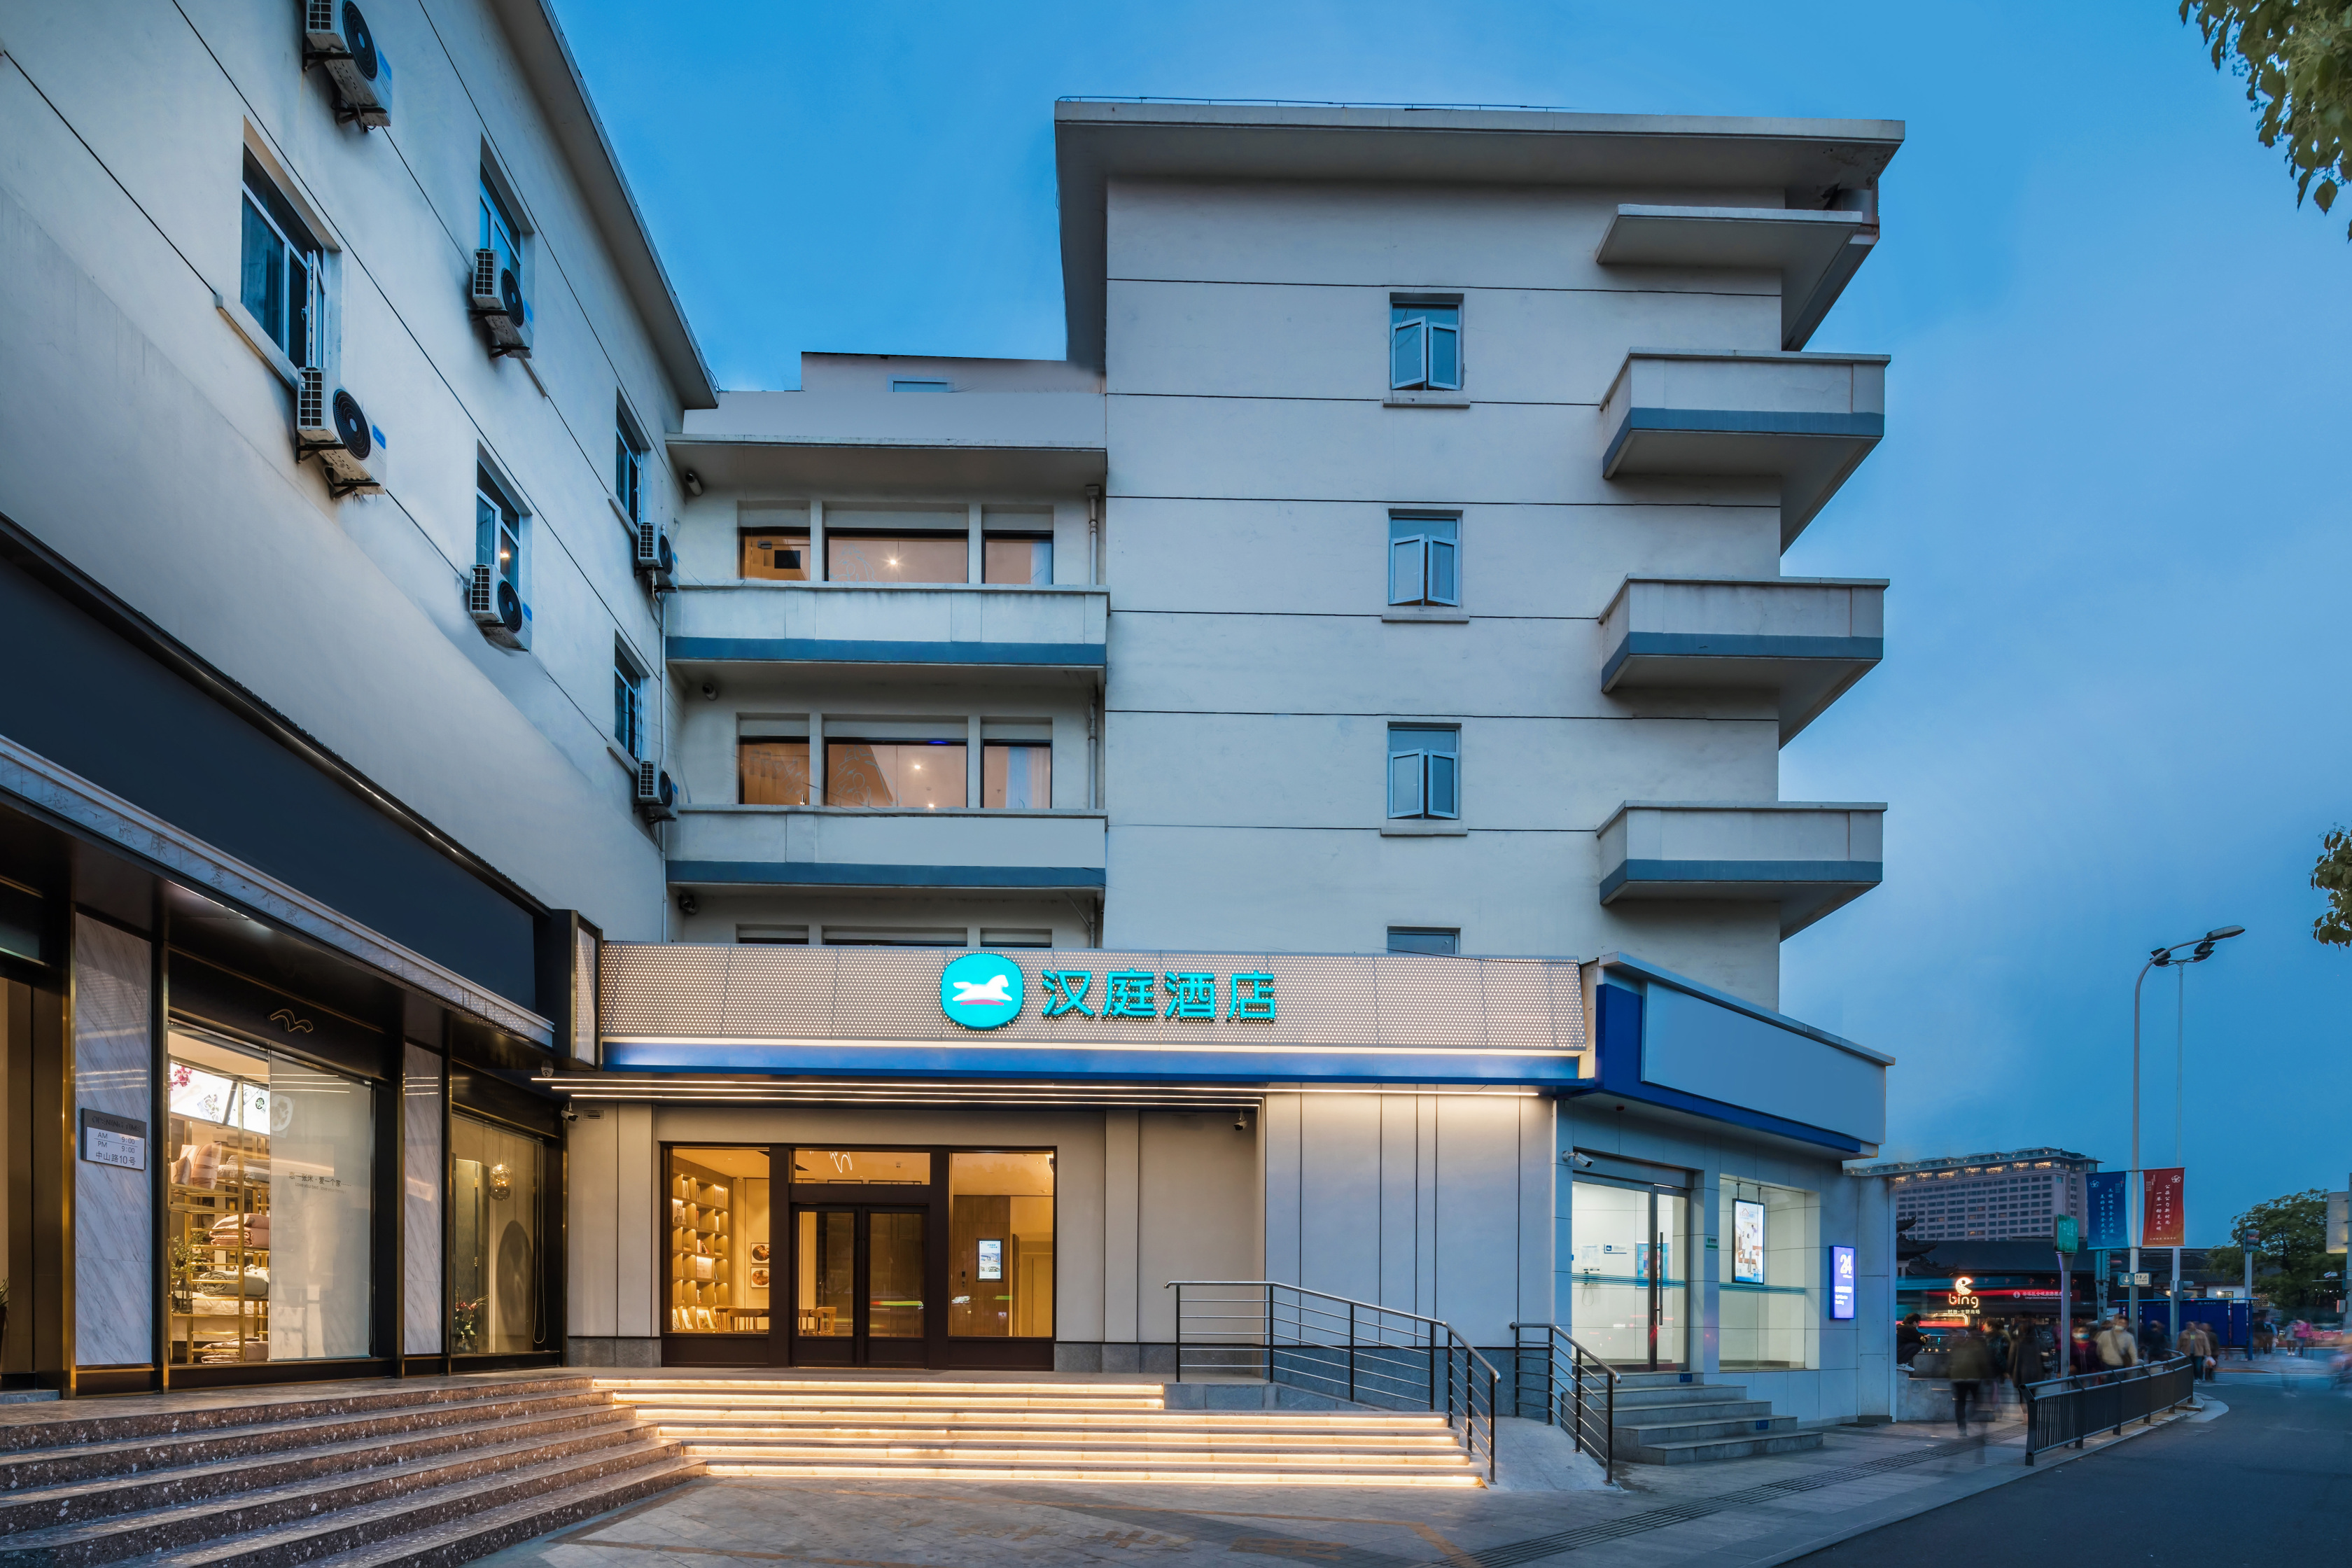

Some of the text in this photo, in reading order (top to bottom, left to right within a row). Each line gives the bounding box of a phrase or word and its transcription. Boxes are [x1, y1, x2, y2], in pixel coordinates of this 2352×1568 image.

[1042, 968, 1275, 1022] 汉庭酒店
[92, 1116, 141, 1133] OPENING TIME
[96, 1151, 136, 1166] 中山路10号
[1840, 1254, 1852, 1274] 24
[1949, 1293, 1979, 1308] bing
